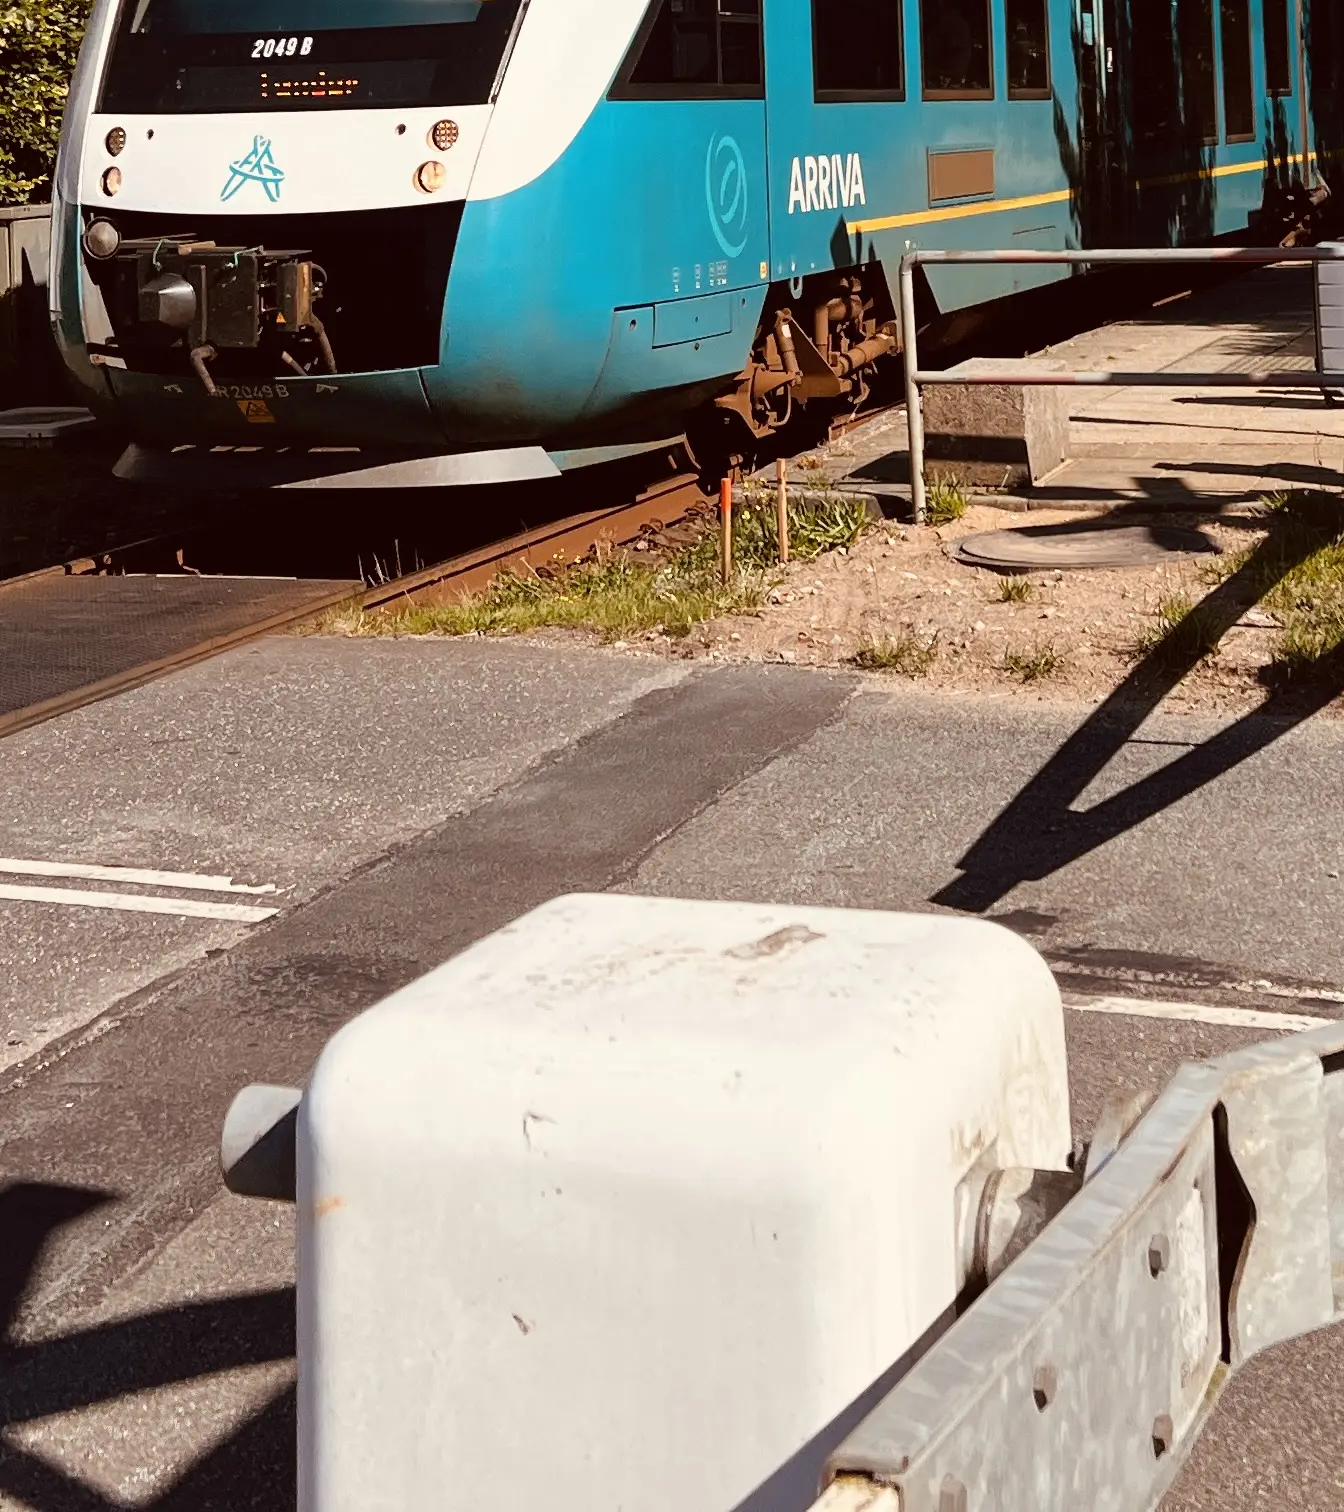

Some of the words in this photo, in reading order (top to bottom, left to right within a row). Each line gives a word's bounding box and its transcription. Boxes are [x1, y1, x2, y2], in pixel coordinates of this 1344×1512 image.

[251, 37, 298, 58] 2049
[300, 36, 314, 56] B
[788, 153, 866, 214] ARRIVA
[230, 384, 274, 399] 2049
